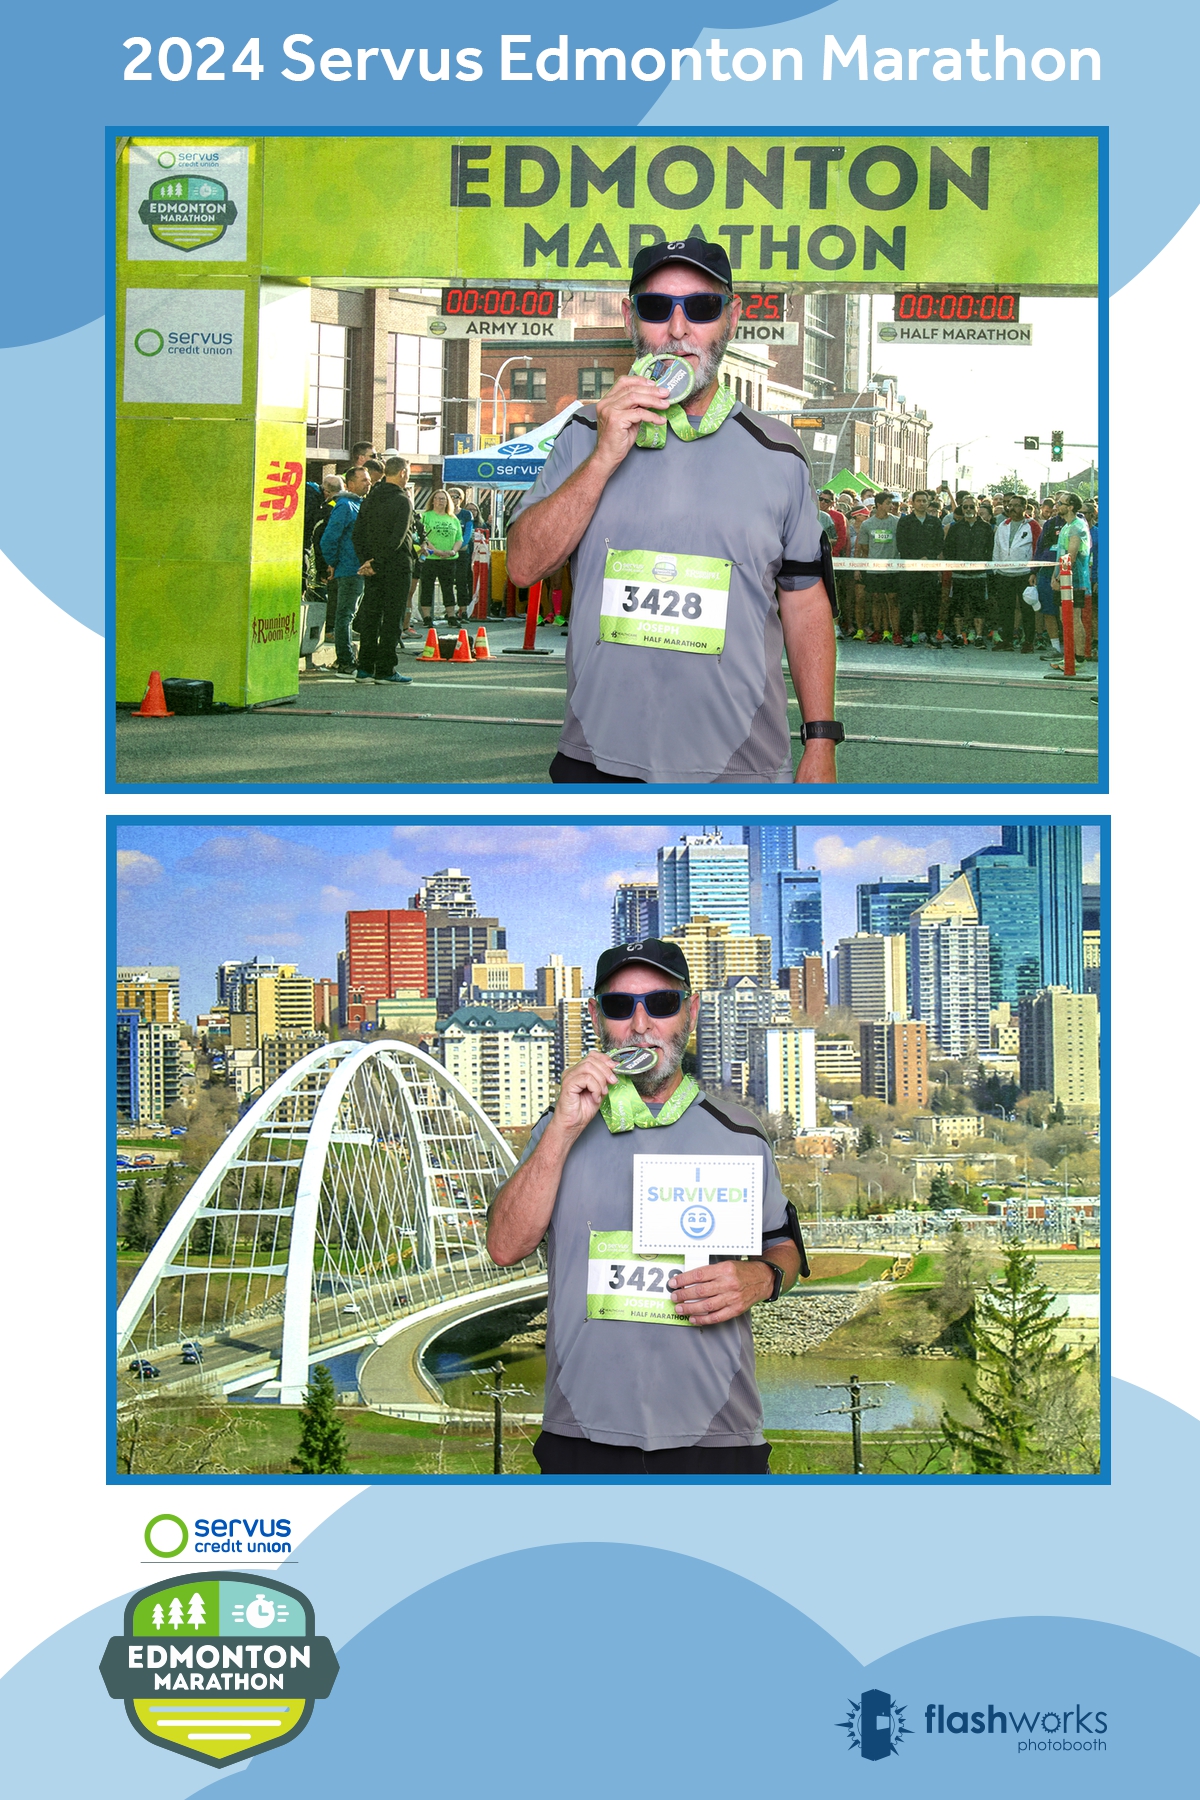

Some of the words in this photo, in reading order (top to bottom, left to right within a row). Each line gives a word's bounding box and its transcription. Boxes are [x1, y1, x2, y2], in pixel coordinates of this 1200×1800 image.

[178, 152, 220, 161] servus
[450, 143, 991, 211] EDMONTON
[149, 203, 227, 214] EDMONTON
[160, 214, 215, 222] MARATHON
[466, 321, 518, 335] ARMY
[522, 322, 554, 336] 10K
[900, 328, 939, 340] HALF
[942, 328, 1031, 341] MARATHON
[168, 332, 233, 345] servus
[168, 345, 200, 355] credit
[203, 347, 233, 355] union
[622, 585, 702, 620] 3428
[636, 621, 680, 635] JOSEPH
[643, 635, 662, 643] HALF
[663, 638, 708, 649] MARATHON
[695, 1167, 700, 1182] I
[647, 1186, 748, 1203] SURVIVED!
[623, 1297, 665, 1310] JOSEPH
[630, 1310, 648, 1318] HALF
